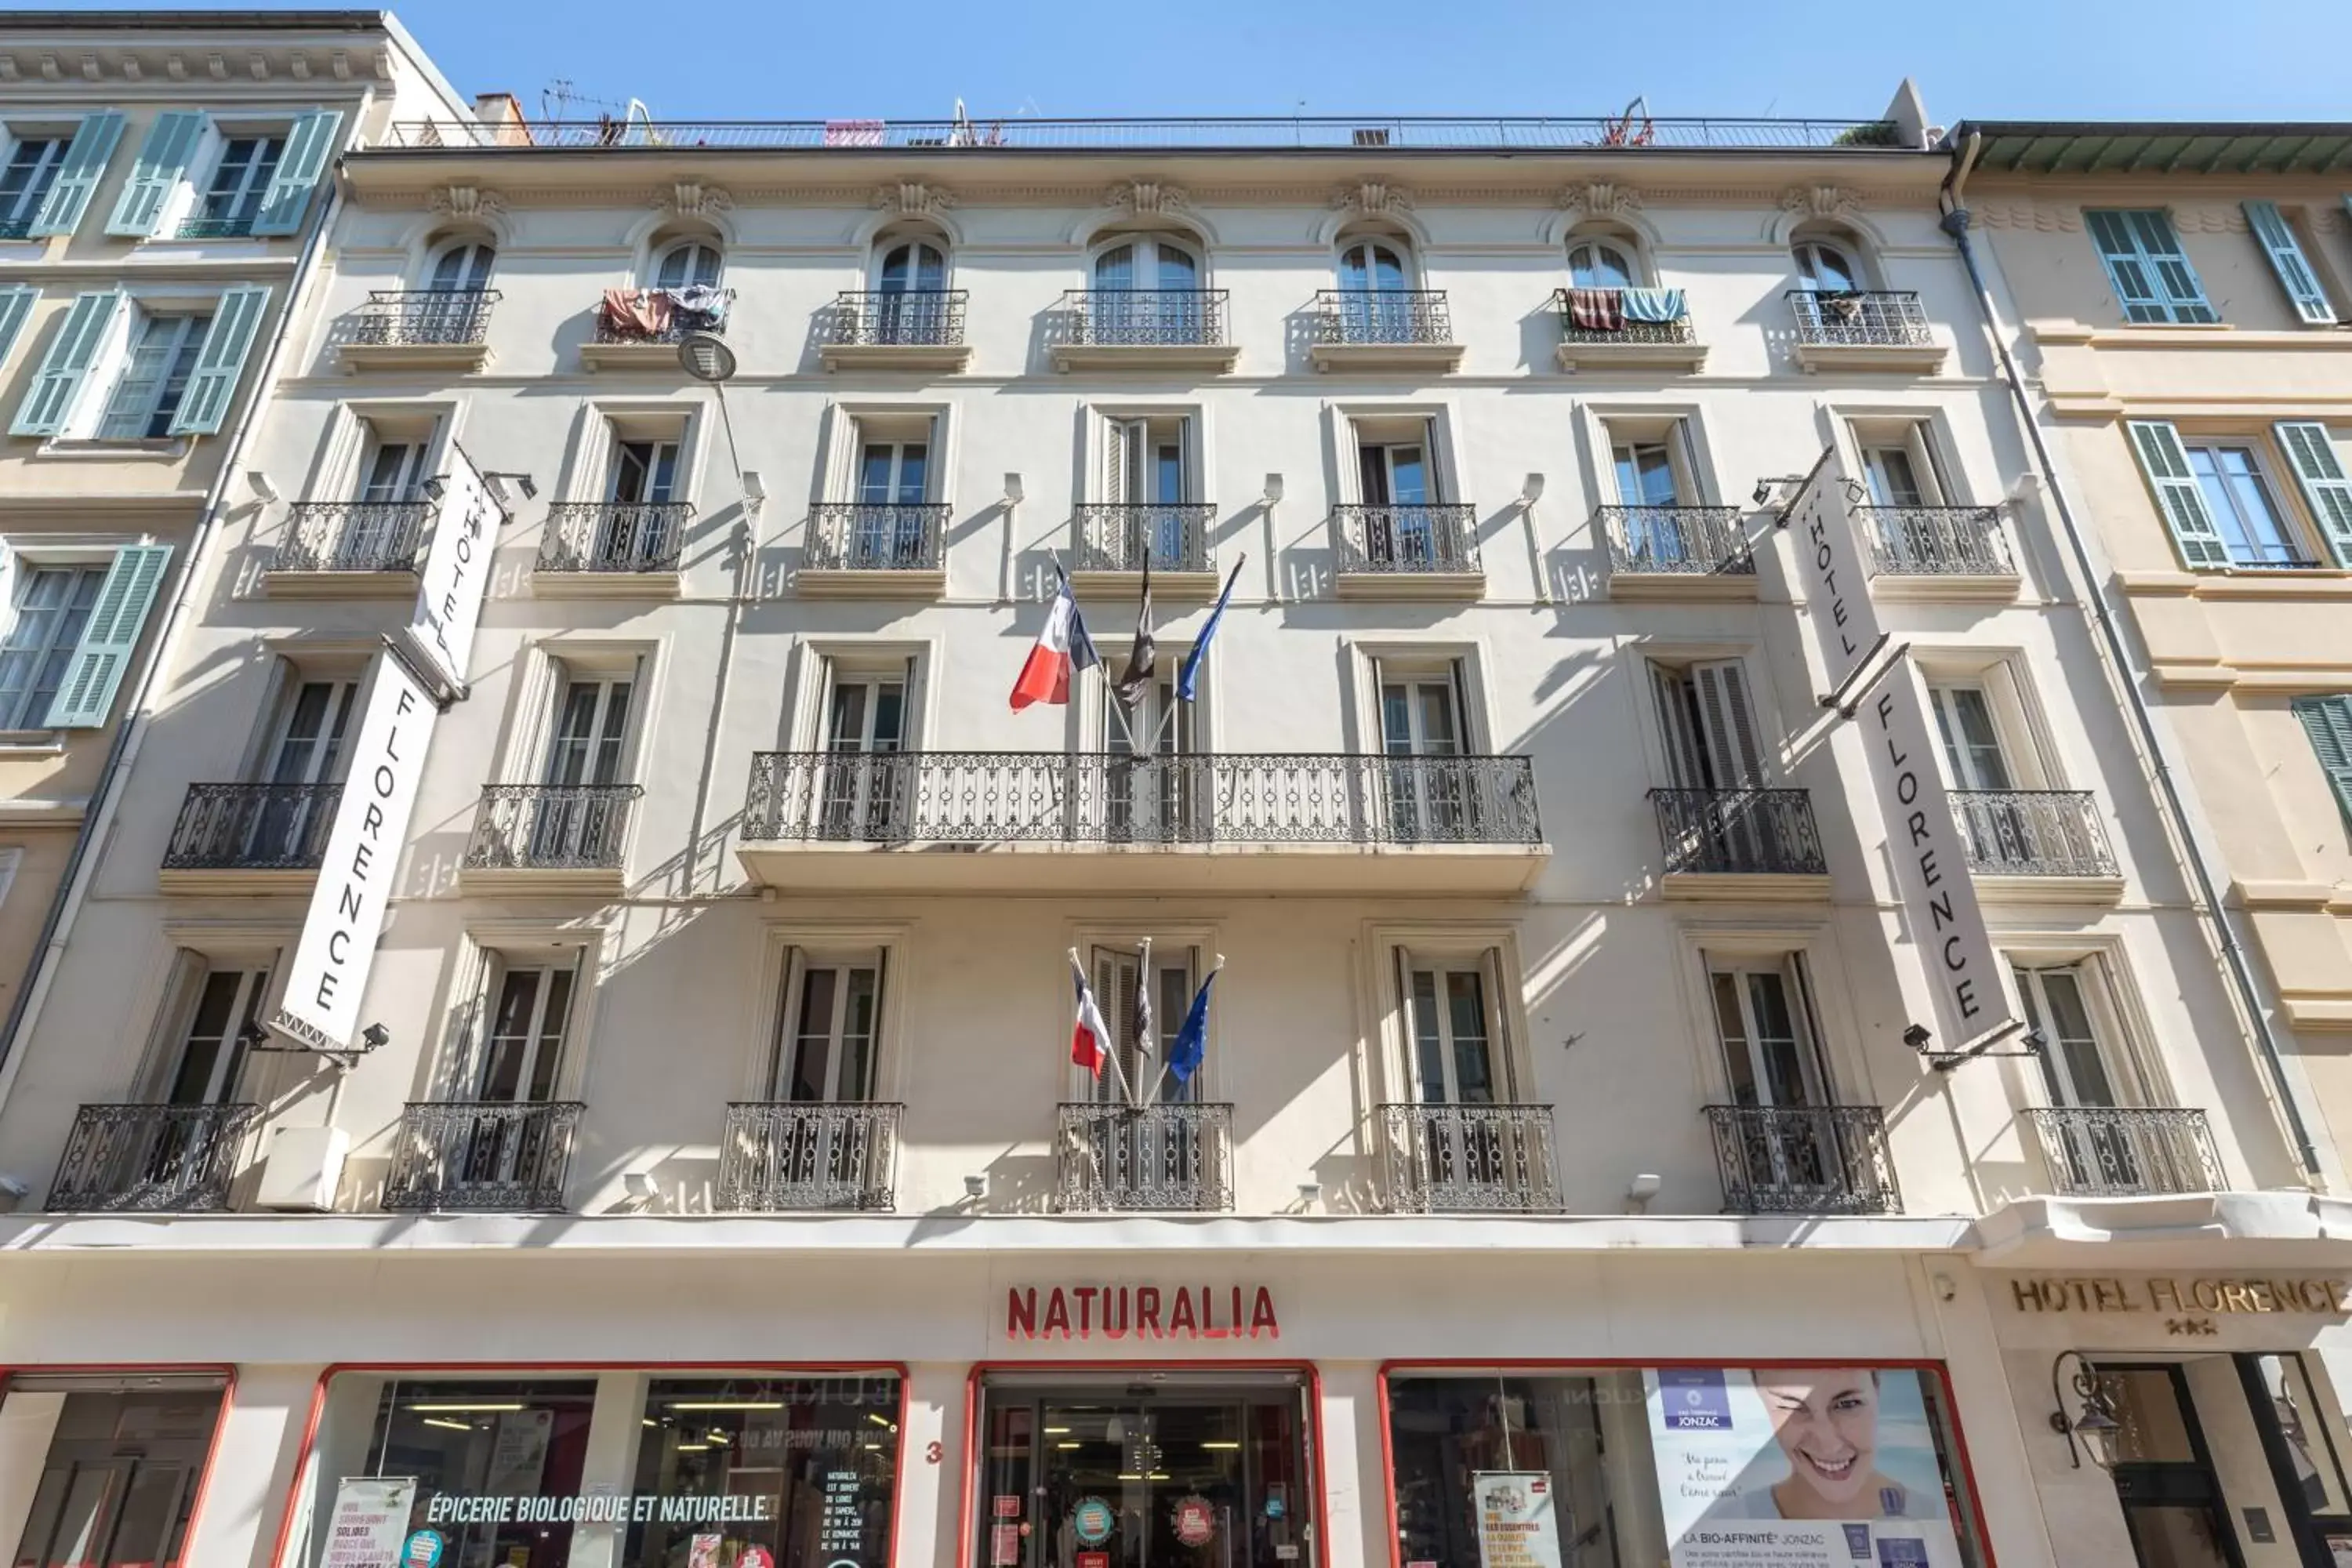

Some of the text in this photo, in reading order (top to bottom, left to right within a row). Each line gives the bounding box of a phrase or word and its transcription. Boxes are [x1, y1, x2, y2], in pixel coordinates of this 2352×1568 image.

[315, 688, 415, 1011] FLORENCE
[1877, 692, 1980, 1019] FLORENCE
[1007, 1286, 1279, 1340] NATURALIA
[2010, 1278, 2142, 1312] HOTEL
[926, 1440, 943, 1465] 3
[426, 1491, 769, 1523] ÉPICERIE BIOLOGIQUE ET NATURELLE.
